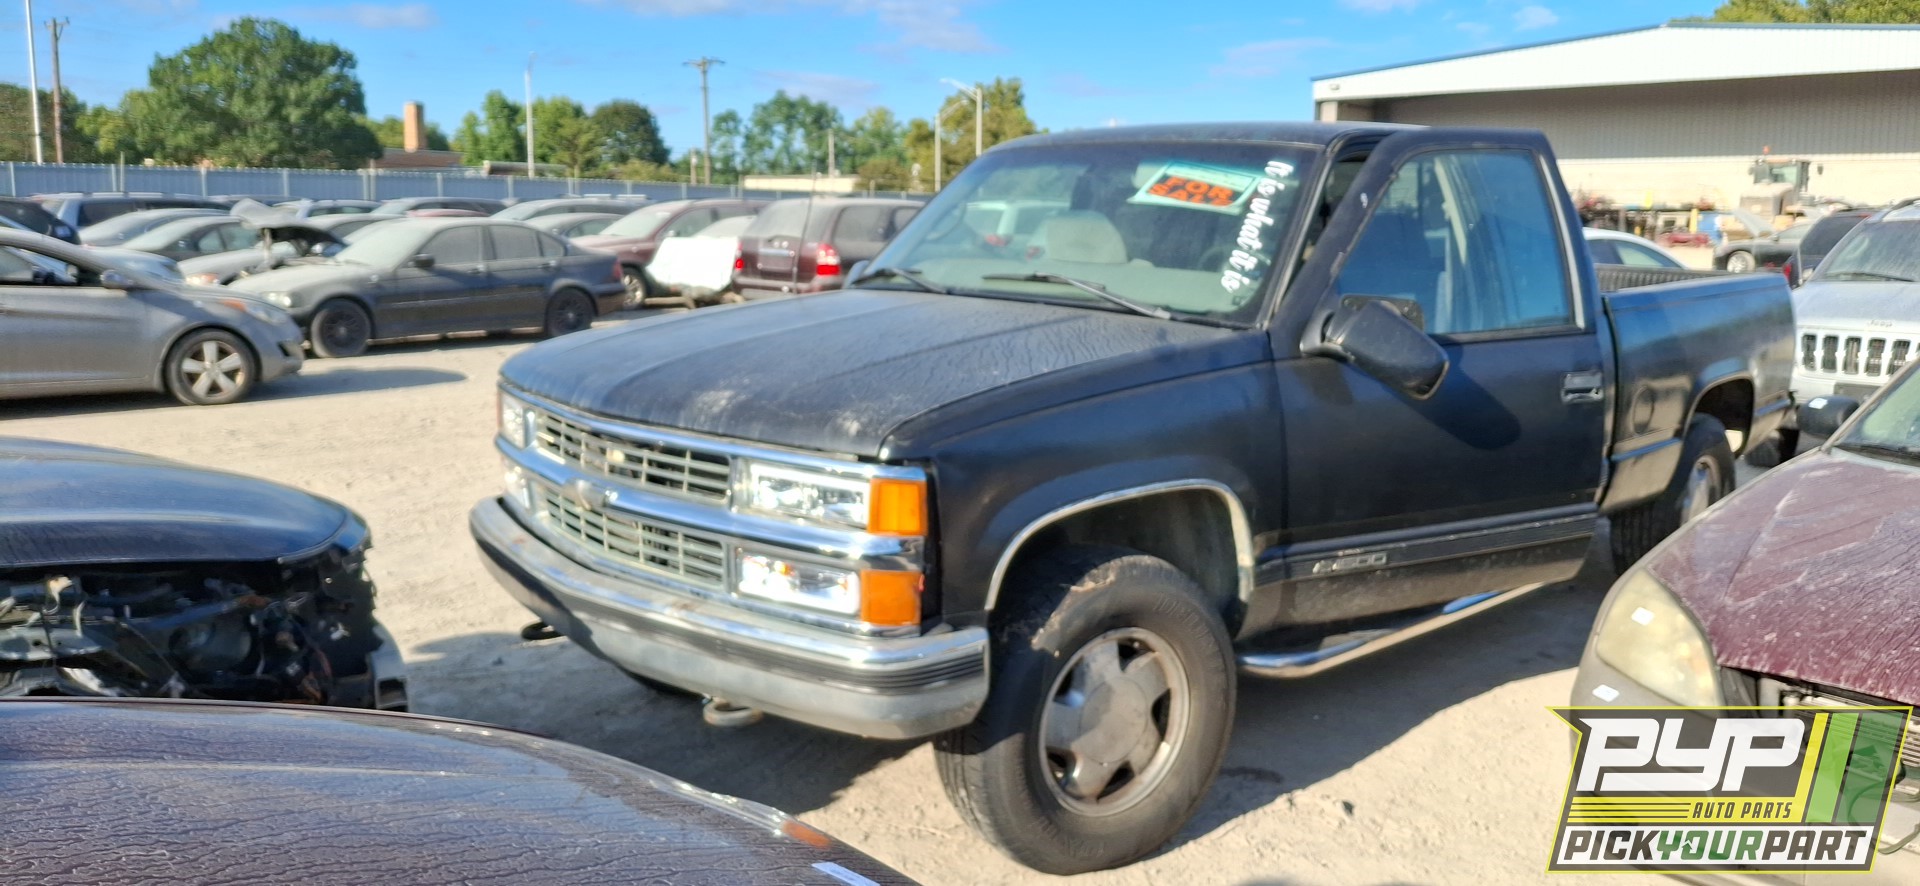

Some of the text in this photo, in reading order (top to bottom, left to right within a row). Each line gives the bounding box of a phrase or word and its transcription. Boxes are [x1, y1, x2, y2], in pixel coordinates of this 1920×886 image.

[1164, 176, 1234, 200] FOR
[1257, 178, 1285, 196] is
[1236, 197, 1274, 251] what
[1229, 249, 1259, 272] it
[1221, 270, 1250, 293] is
